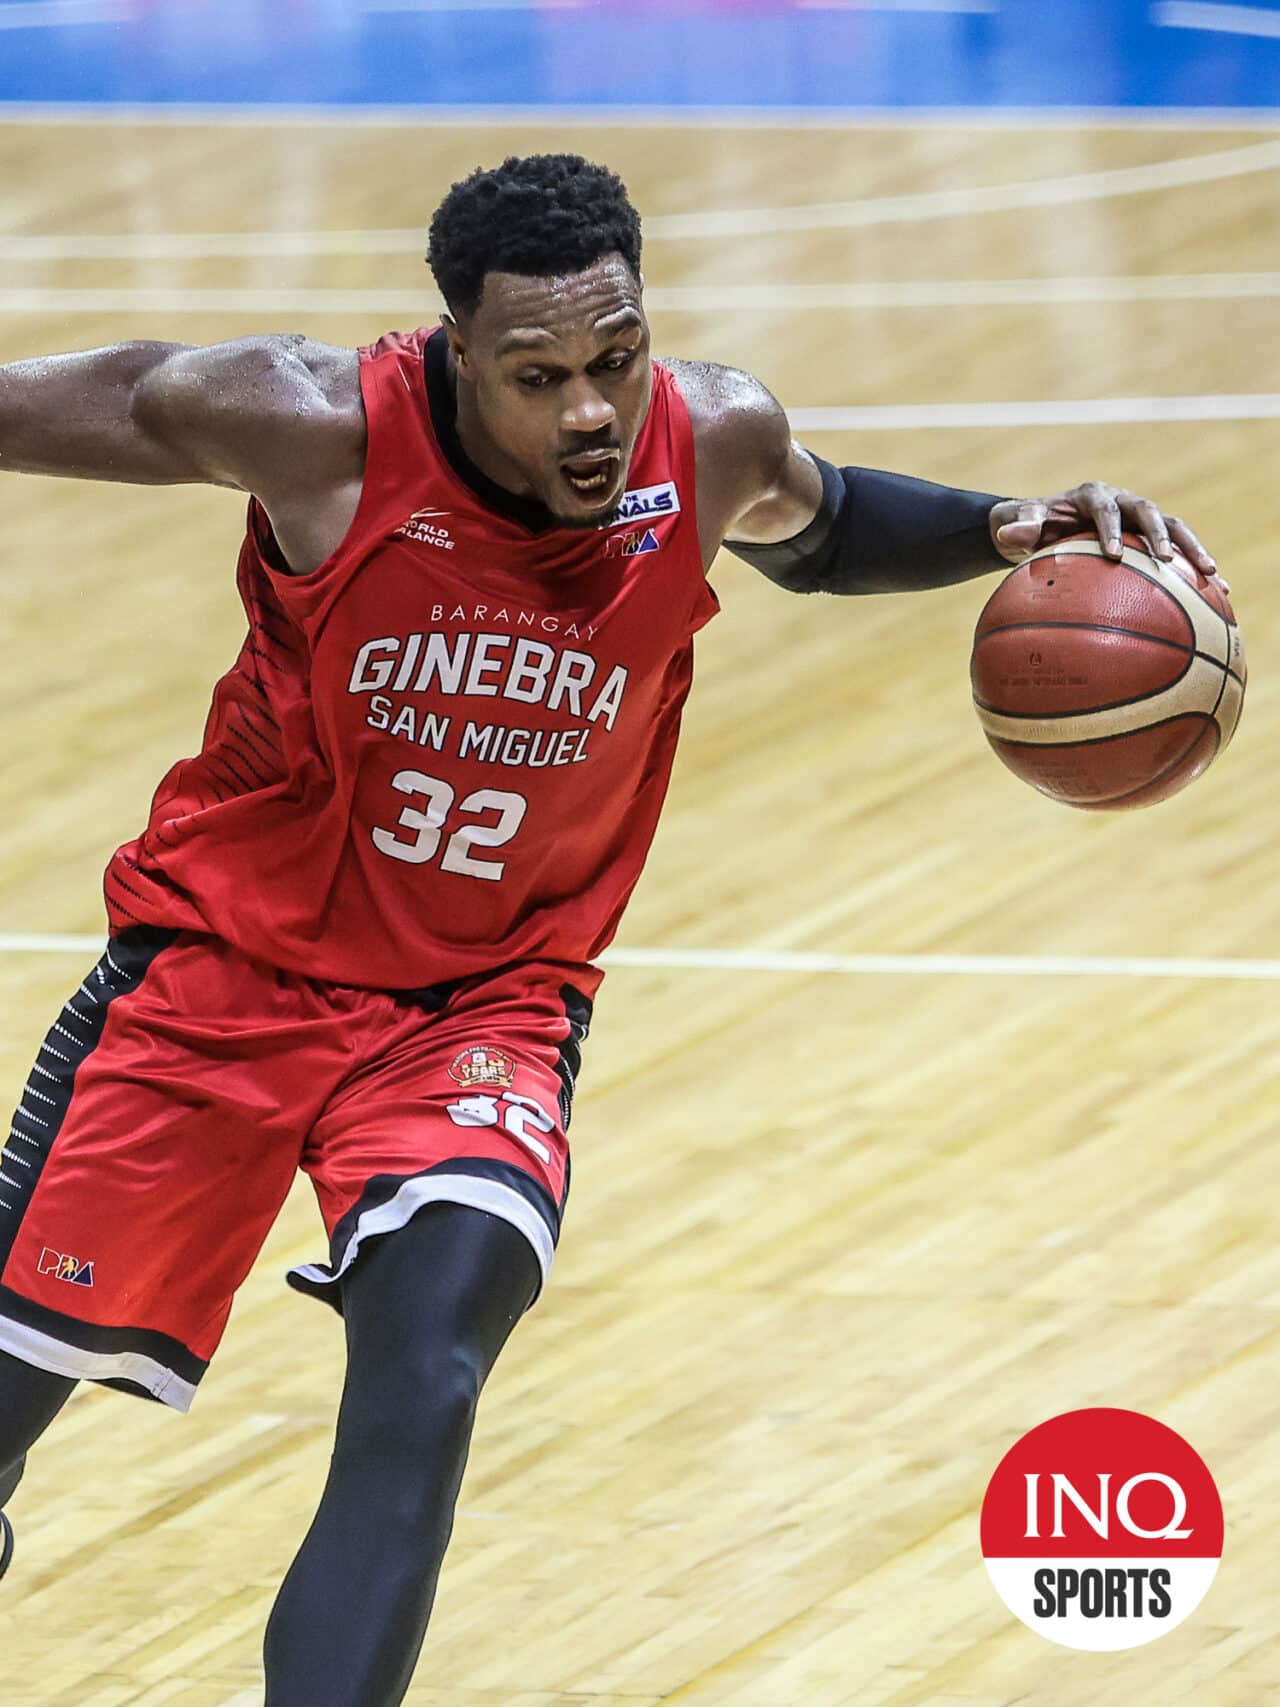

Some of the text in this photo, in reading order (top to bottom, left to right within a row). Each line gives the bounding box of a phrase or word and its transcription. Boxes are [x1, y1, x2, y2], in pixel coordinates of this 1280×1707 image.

[613, 490, 673, 519] NALS
[430, 603, 599, 642] BARANGAY
[347, 632, 629, 733] GINEBRA
[366, 694, 592, 768] SAN MIGUEL
[371, 769, 529, 882] 32
[37, 1246, 95, 1288] PBA
